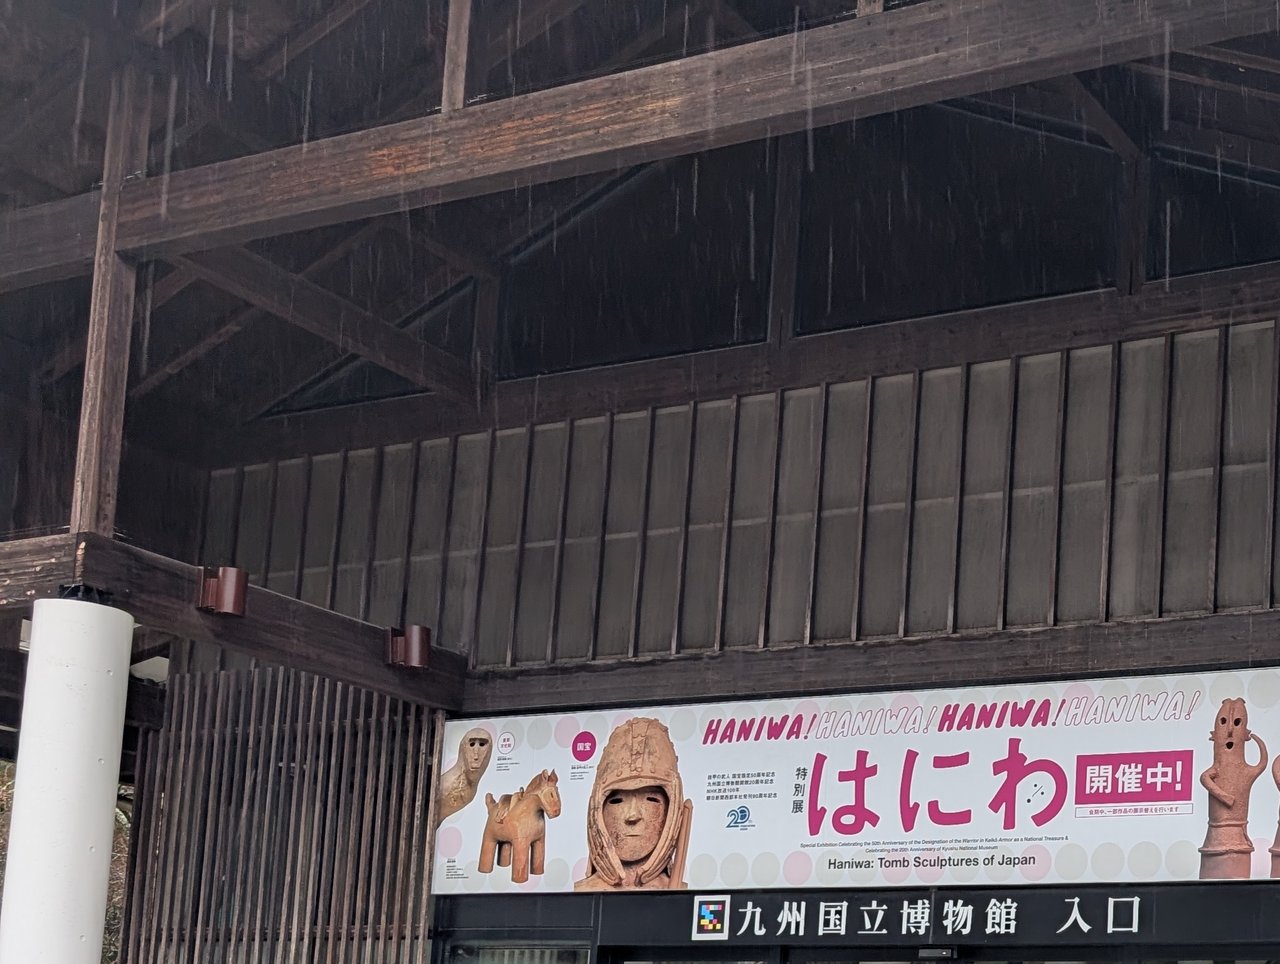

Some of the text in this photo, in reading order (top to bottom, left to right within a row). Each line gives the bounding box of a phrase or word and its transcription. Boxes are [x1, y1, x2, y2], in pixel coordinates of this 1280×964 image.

[702, 690, 1201, 745] HANIWA! HANIWA! HANIWA! HANIWA!
[576, 742, 592, 752] 国宝
[791, 766, 808, 814] 特別展
[808, 738, 1068, 836] はにわ
[1085, 760, 1183, 795] 開催中!
[828, 854, 1036, 870] Haniwa: Tomb Sculptures of Japan
[736, 896, 1141, 937] 九州国立博物館 入口
